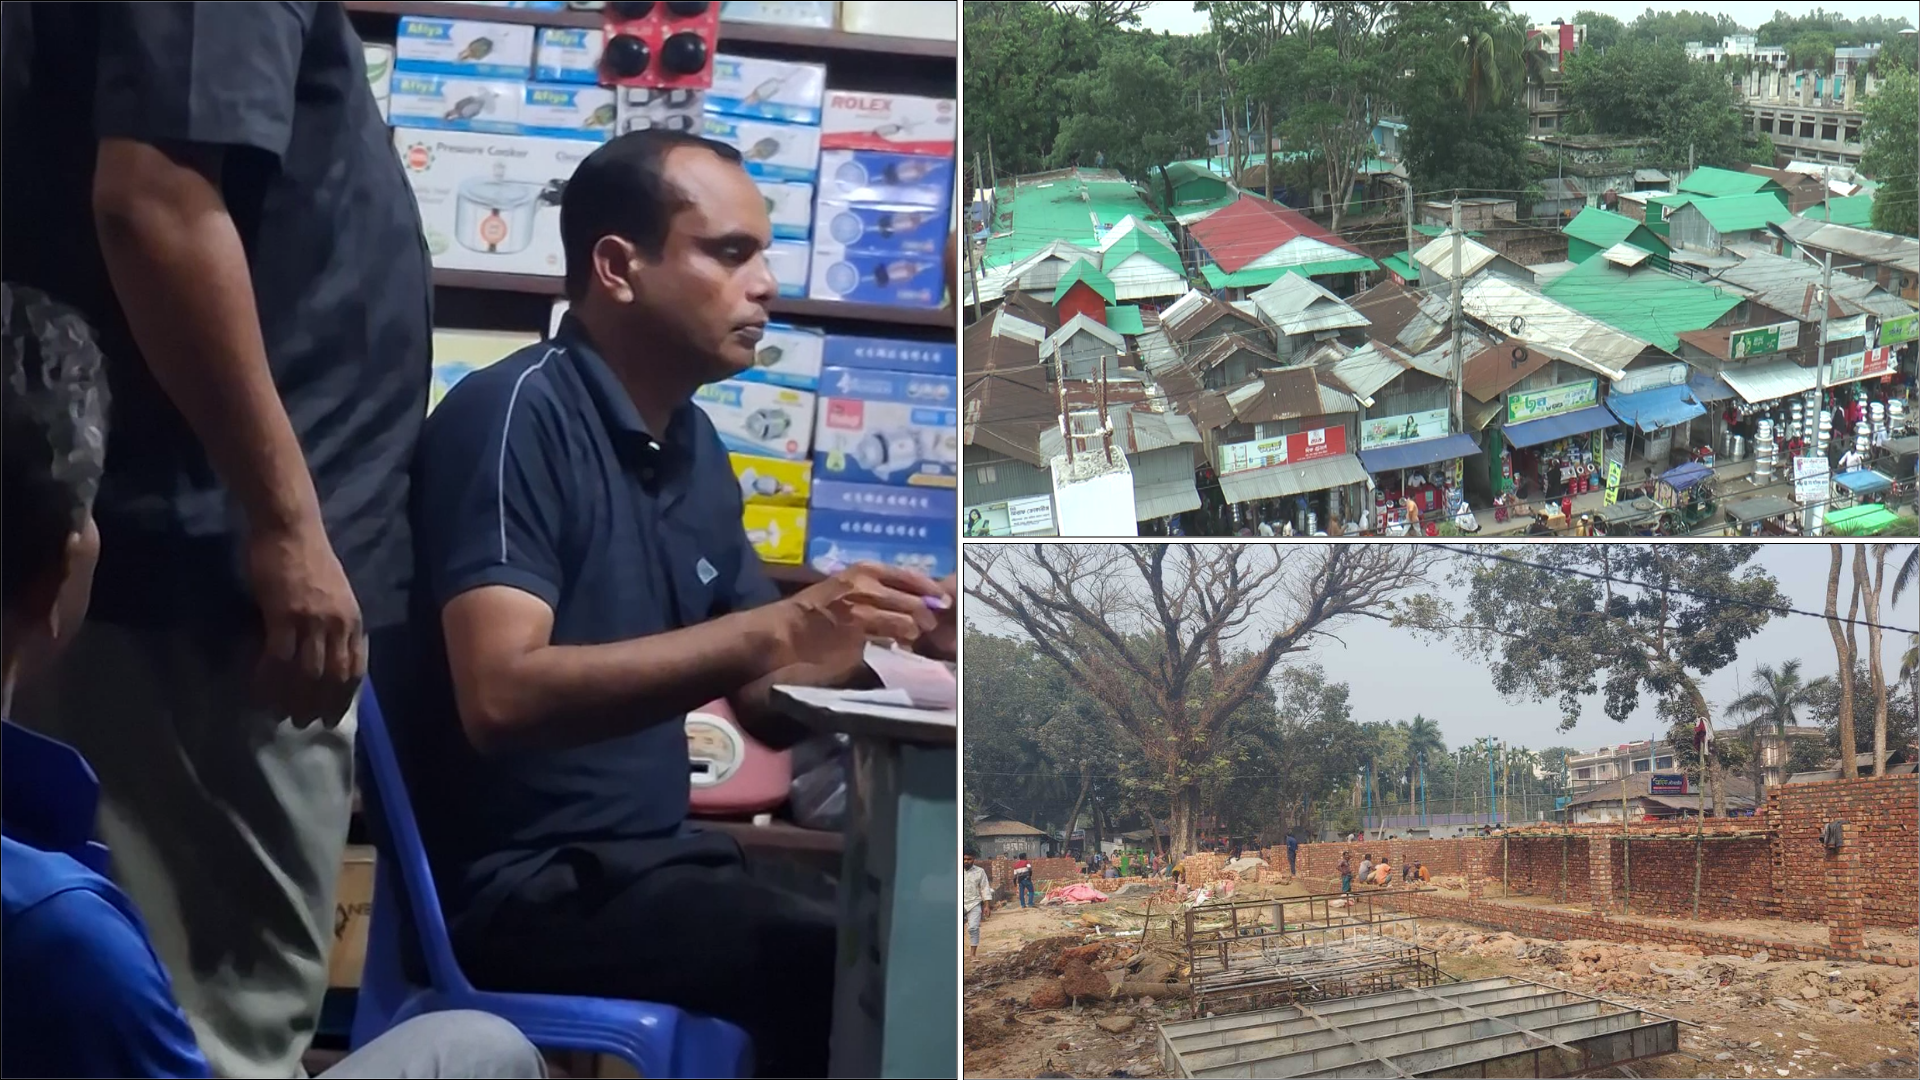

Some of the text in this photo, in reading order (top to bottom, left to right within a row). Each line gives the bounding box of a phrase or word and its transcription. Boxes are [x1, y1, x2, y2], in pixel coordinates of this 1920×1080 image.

[830, 95, 890, 111] ROLEX
[436, 141, 529, 158] Pressure Cooker
